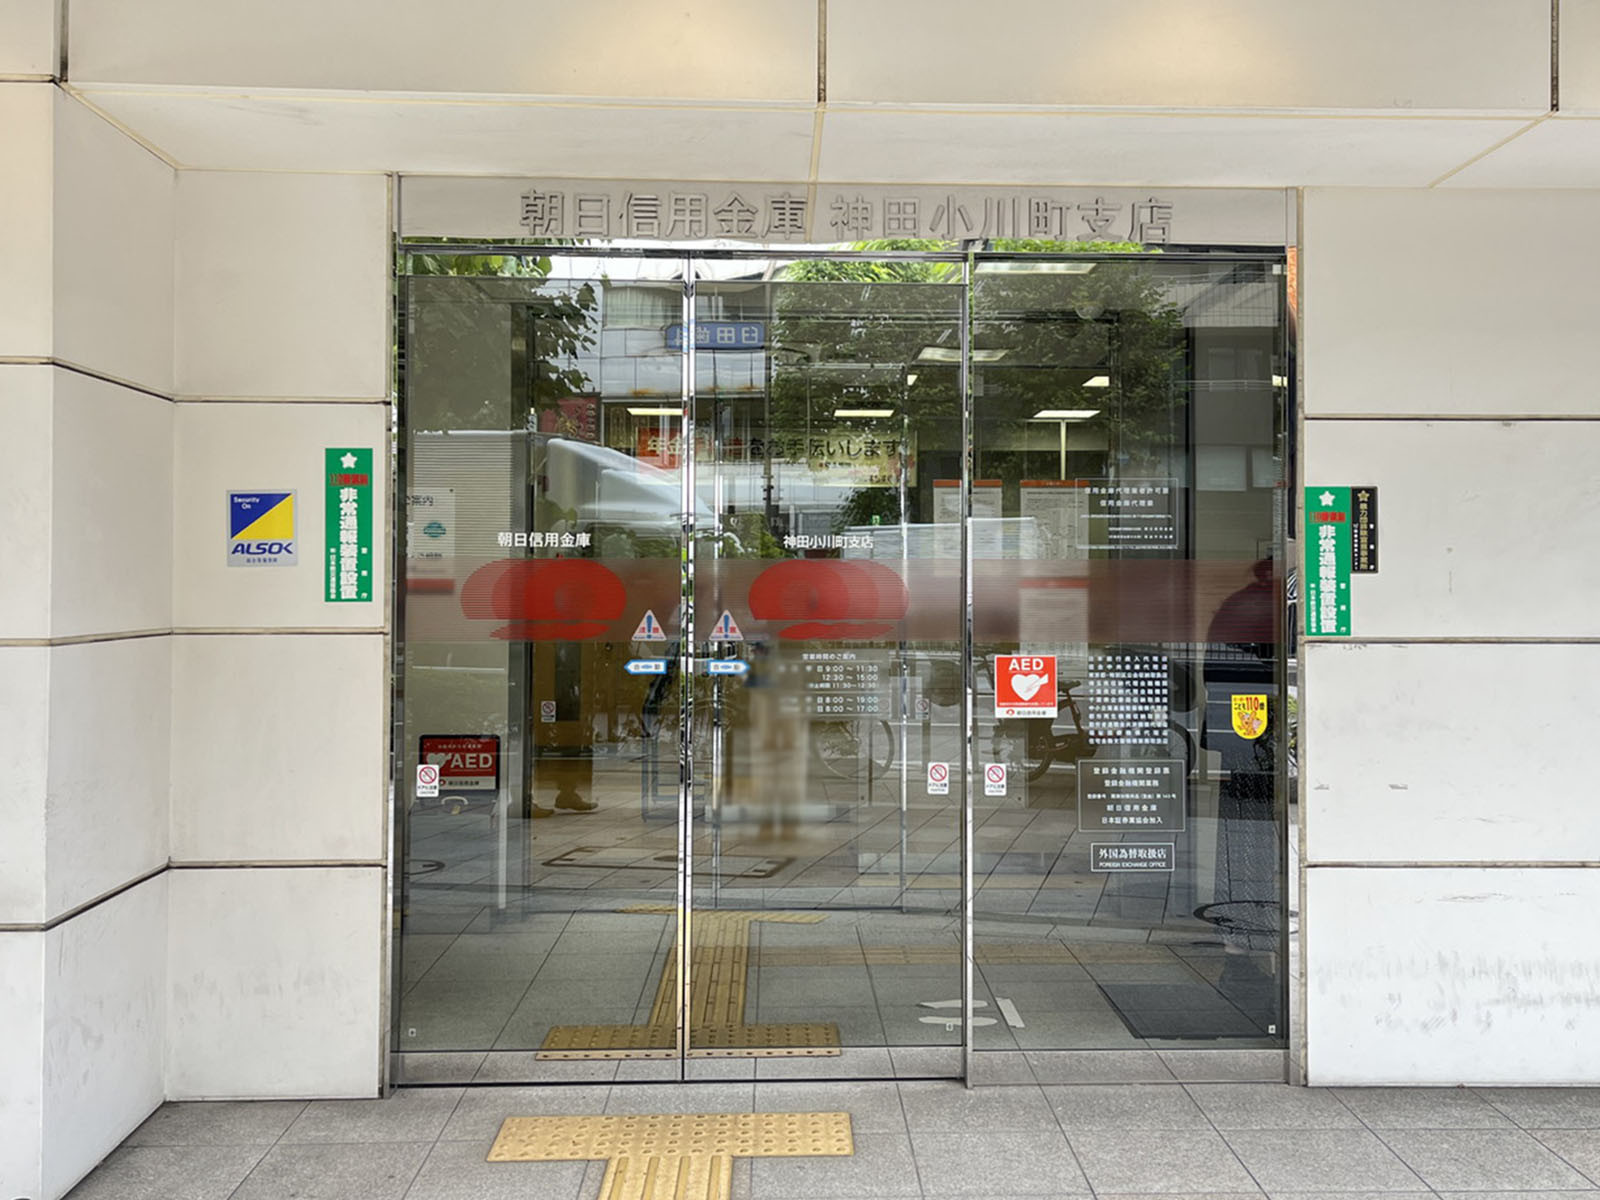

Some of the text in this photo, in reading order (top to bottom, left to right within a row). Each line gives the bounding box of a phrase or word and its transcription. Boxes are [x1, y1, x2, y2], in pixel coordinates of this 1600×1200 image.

[520, 189, 1173, 243] 朝日信用金庫 神田小川町支店
[498, 532, 591, 548] 朝日信用金庫
[784, 535, 874, 549] 神田小川町支店
[231, 542, 293, 555] ALSOK
[1009, 658, 1044, 670] AED
[450, 753, 492, 768] AED
